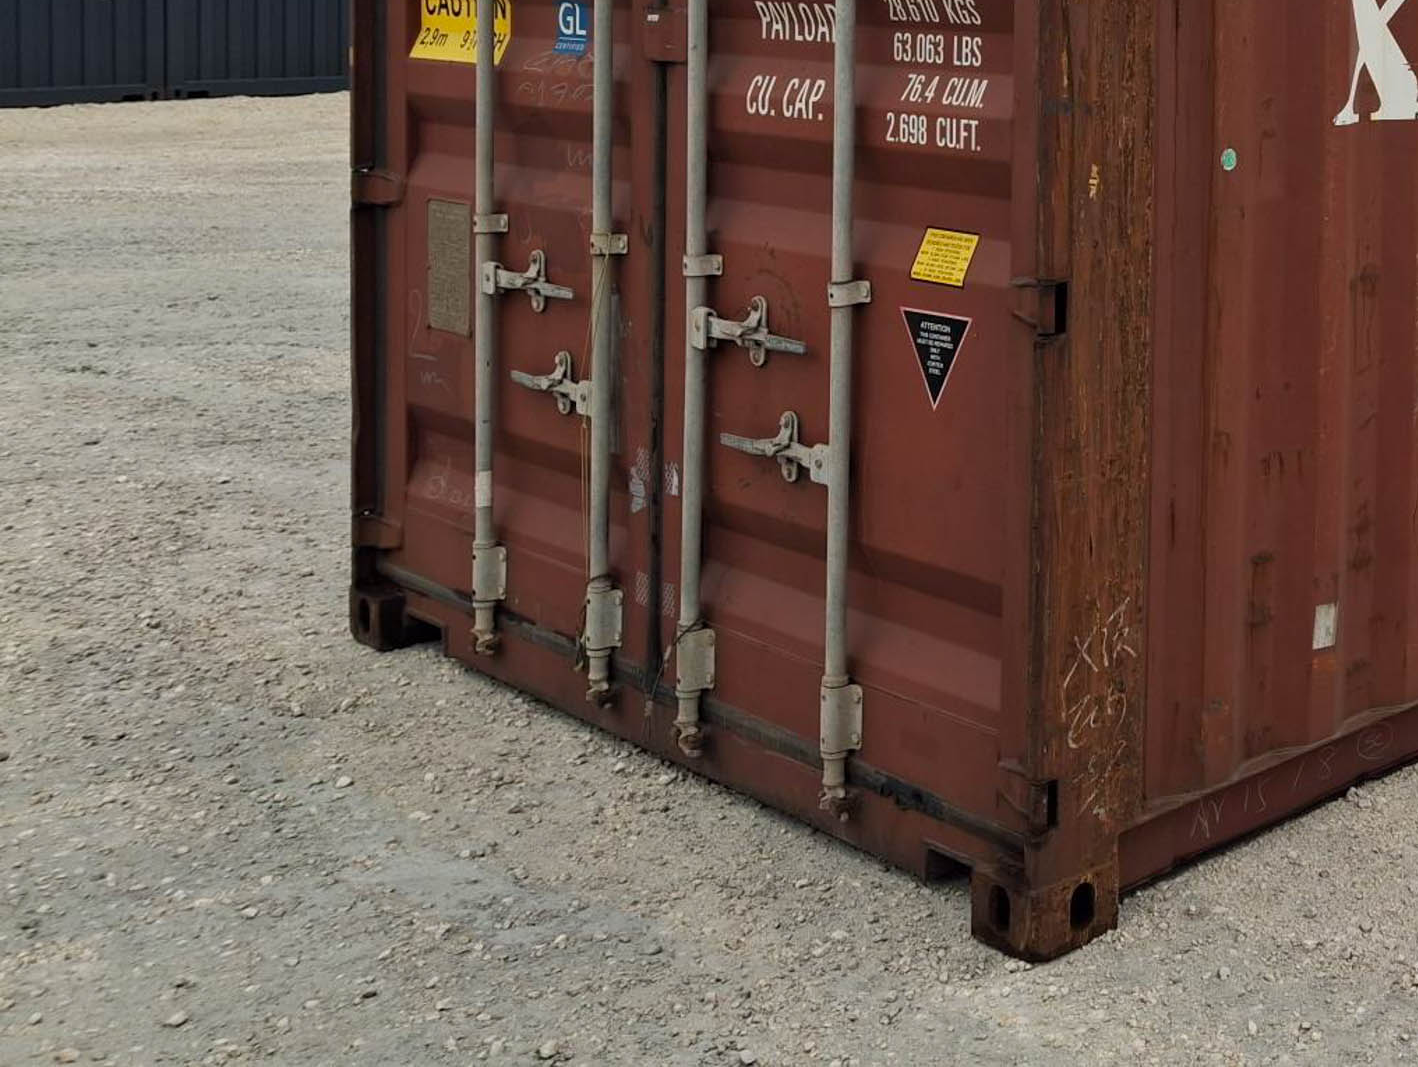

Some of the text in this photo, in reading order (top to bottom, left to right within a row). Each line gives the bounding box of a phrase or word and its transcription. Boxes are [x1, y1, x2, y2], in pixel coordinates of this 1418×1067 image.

[559, 2, 587, 36] GL
[893, 32, 982, 67] 63.063 LBS
[746, 73, 988, 121] CU. CAP. 76.4 CU.M.
[886, 112, 981, 151] 2.698 CU.FT.
[920, 321, 951, 333] ATTENTION
